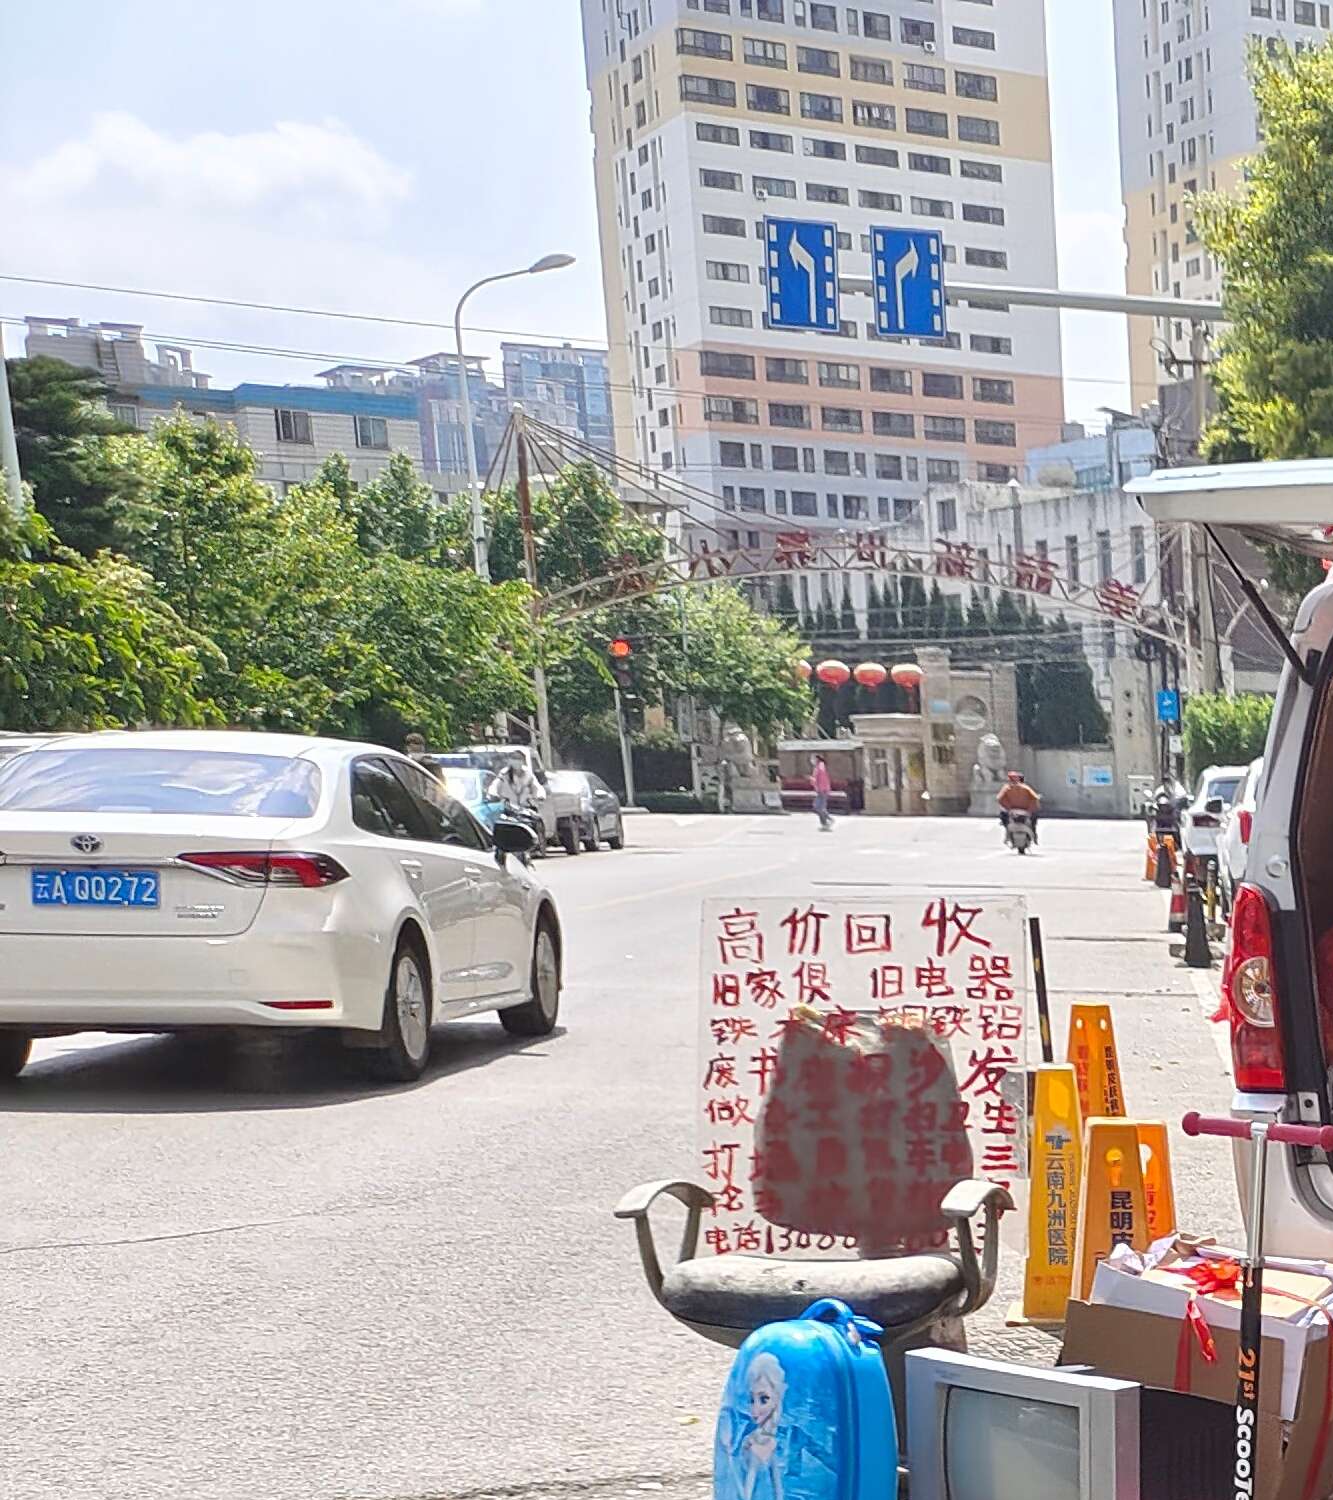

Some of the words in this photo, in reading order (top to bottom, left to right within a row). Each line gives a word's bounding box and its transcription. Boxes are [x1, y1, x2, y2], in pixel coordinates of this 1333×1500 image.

[717, 897, 992, 965] 高价回收
[1045, 1152, 1068, 1266] 云南九洲医院
[1238, 1346, 1257, 1400] 21st
